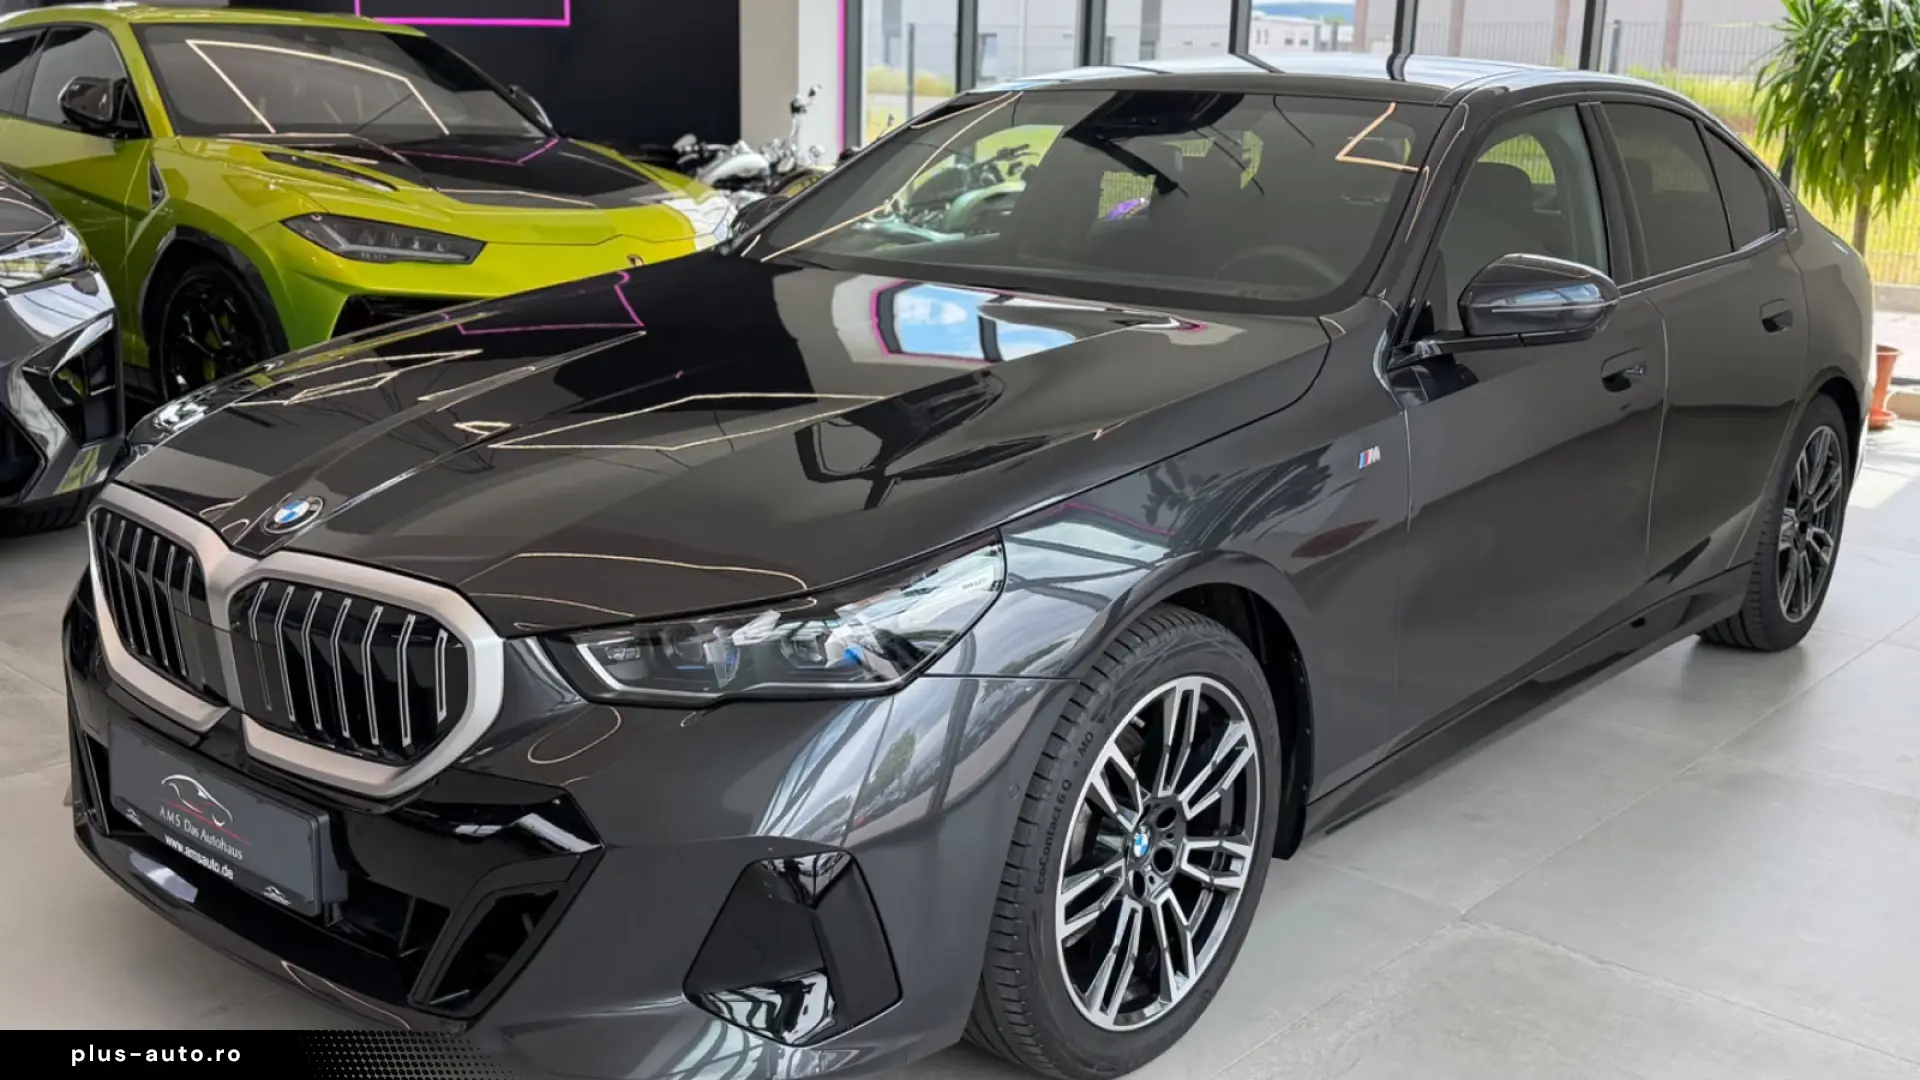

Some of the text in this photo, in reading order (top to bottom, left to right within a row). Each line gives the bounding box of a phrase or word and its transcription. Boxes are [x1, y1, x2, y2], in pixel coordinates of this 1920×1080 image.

[159, 805, 181, 828] AMS
[183, 818, 200, 839] Das
[200, 828, 243, 860] Autohaus
[1034, 806, 1062, 895] EcoContact
[1077, 731, 1094, 757] MO
[164, 833, 234, 880] www.amsauto.de
